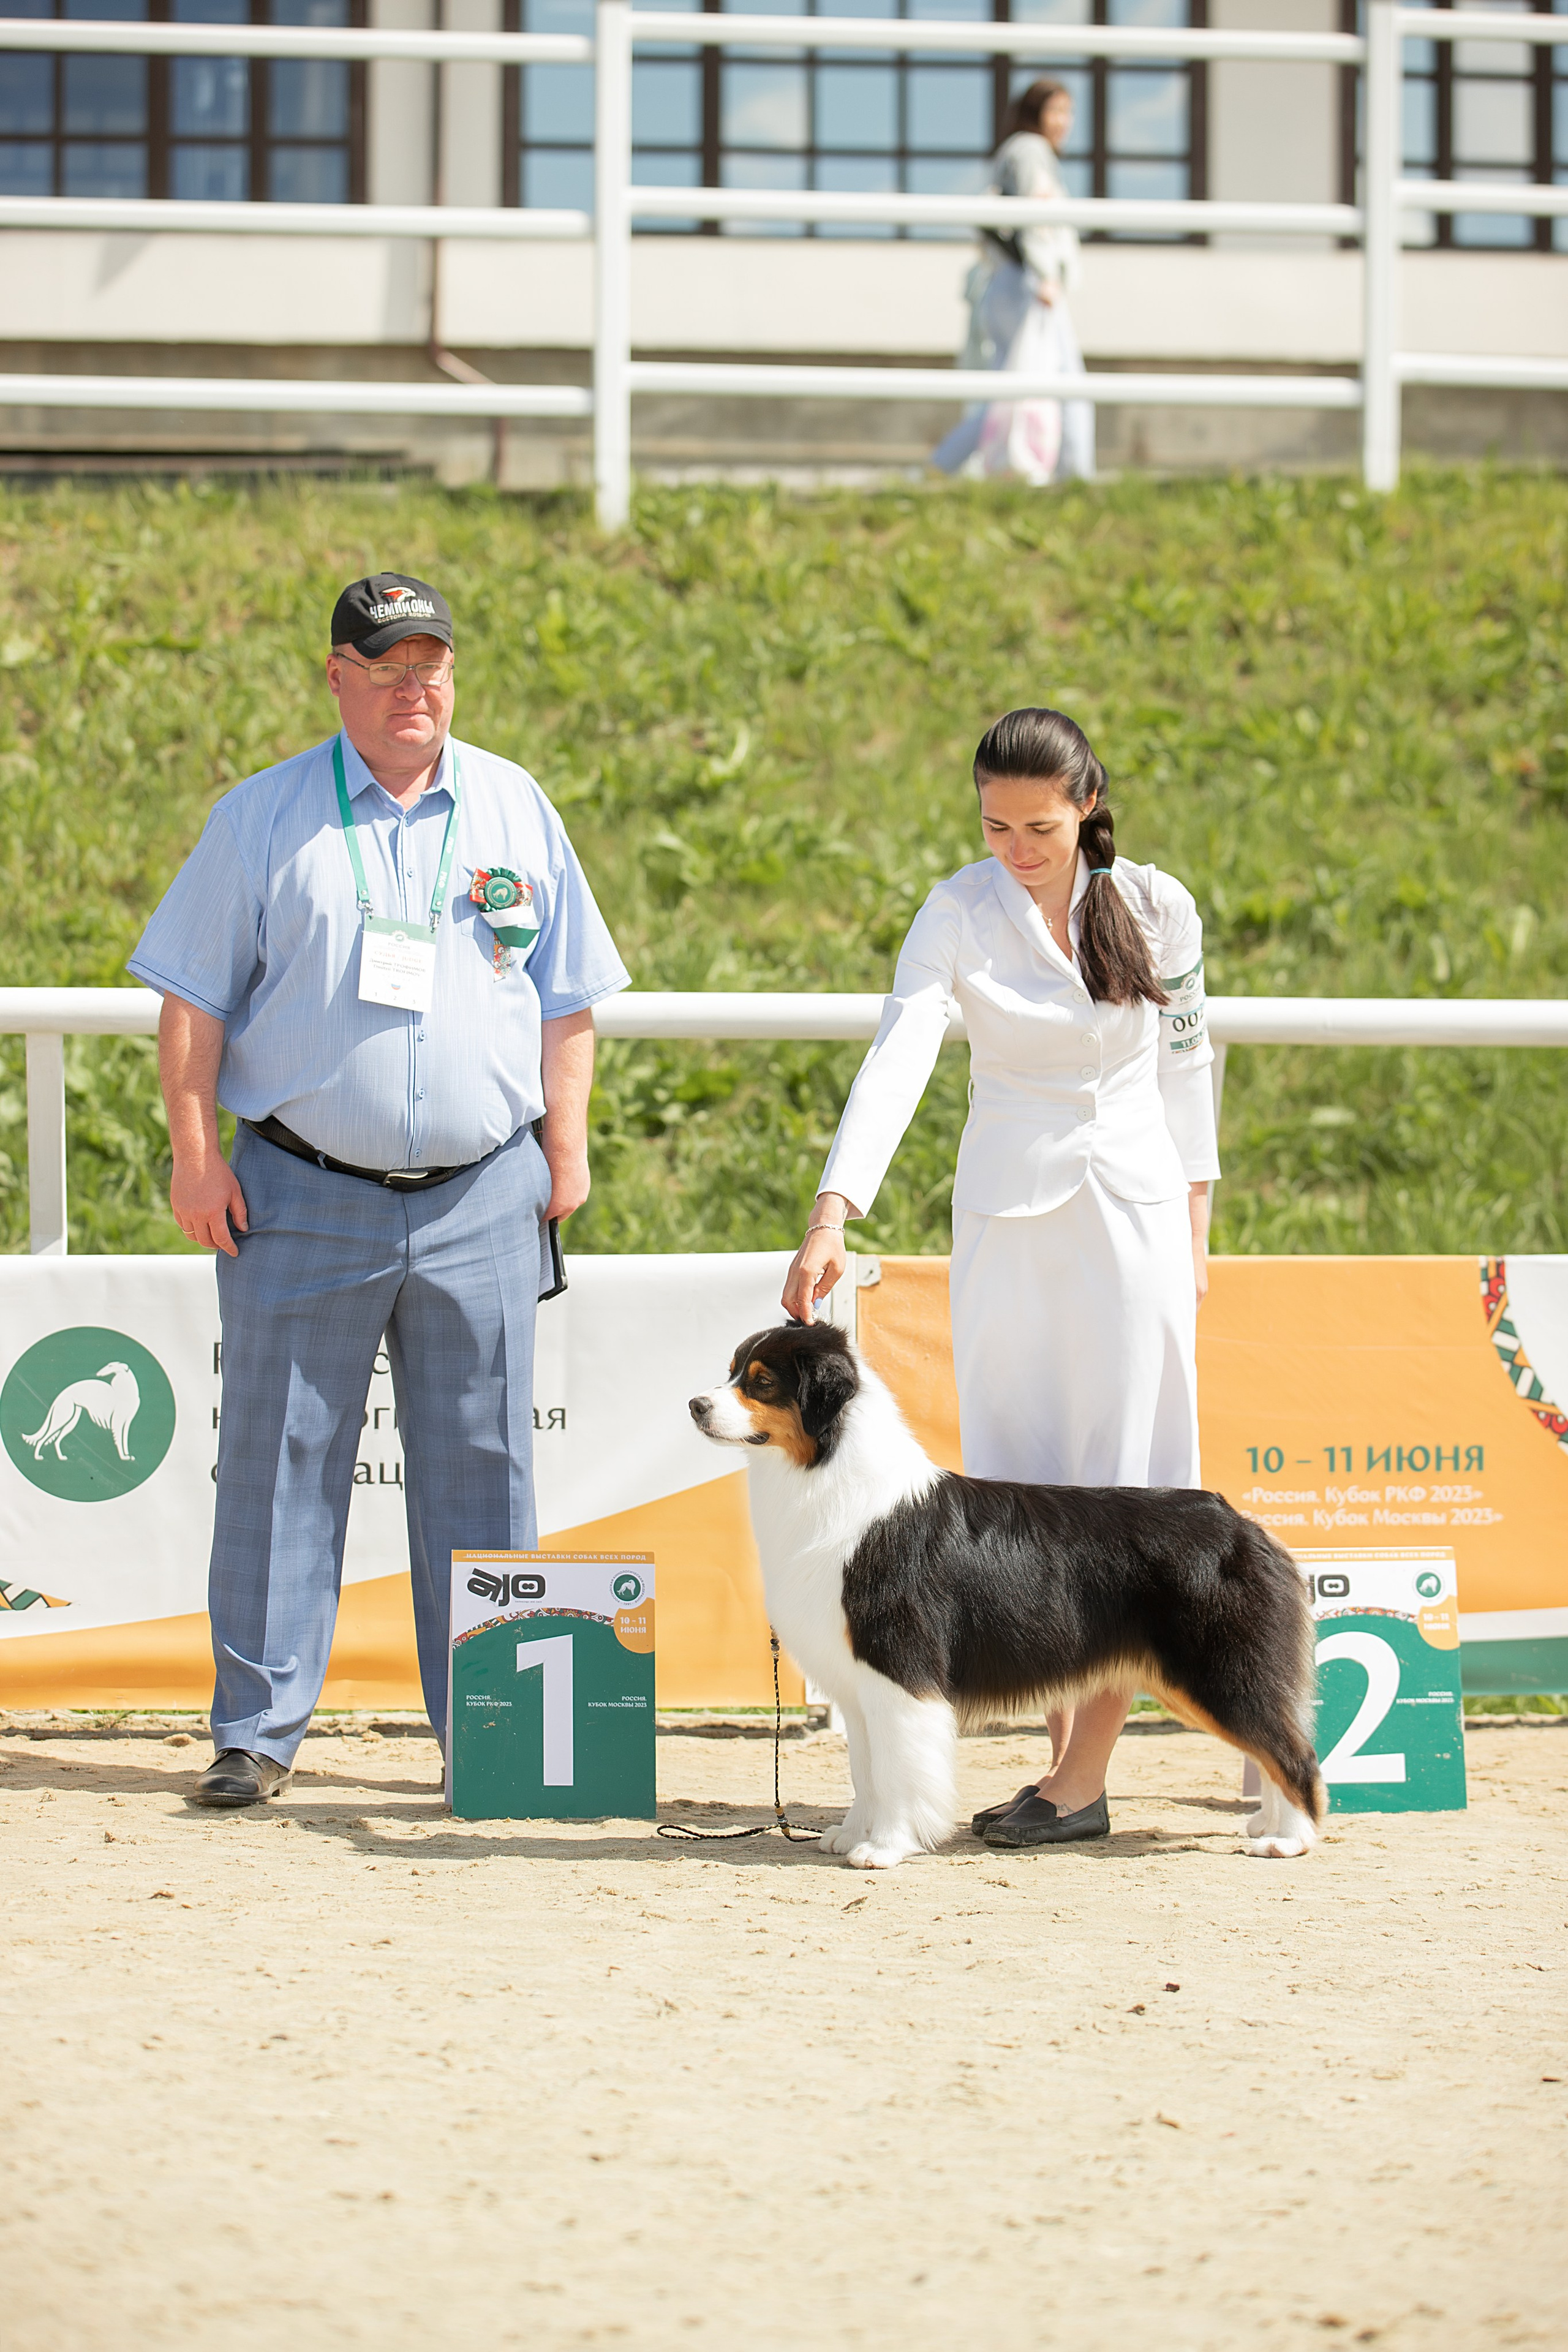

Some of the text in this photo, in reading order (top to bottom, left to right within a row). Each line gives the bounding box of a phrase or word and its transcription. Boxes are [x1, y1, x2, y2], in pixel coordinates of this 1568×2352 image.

[369, 599, 435, 619] ЧЕМПИОНЫ
[1245, 1446, 1285, 1473] 10
[1323, 1446, 1352, 1473] 11
[1366, 1445, 1484, 1473] ИЮНЯ
[1242, 1484, 1483, 1507] «Россия. Кубок РКФ 2023»
[1313, 1508, 1369, 1531] Кубок
[1373, 1508, 1446, 1526] Москвы
[1450, 1507, 1504, 1525] 2023»
[516, 1634, 573, 1786] 1
[1315, 1631, 1406, 1784] 2
